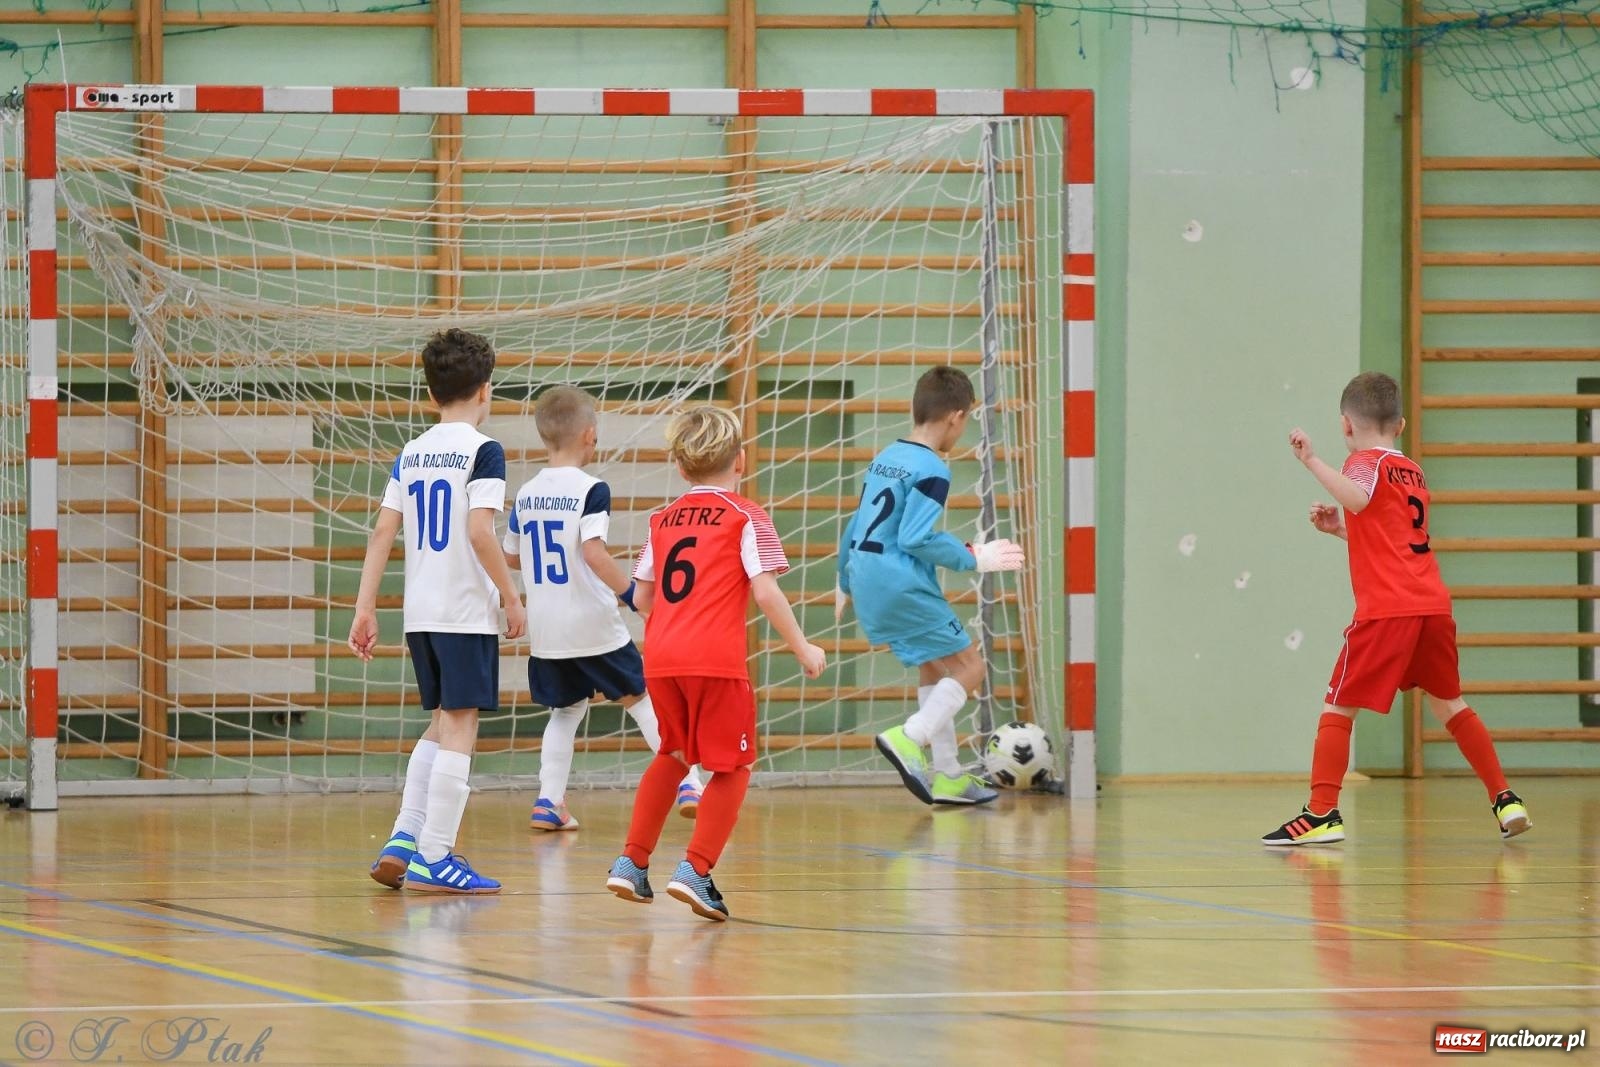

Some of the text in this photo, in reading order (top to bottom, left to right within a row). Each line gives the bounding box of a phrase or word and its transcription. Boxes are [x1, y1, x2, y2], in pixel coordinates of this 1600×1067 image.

[131, 92, 174, 106] sport
[408, 479, 452, 552] 10
[534, 496, 580, 512] RACIBÓRZ
[659, 507, 727, 530] KIETRZ
[523, 520, 569, 585] 15
[661, 536, 697, 604] 6
[740, 733, 748, 752] 6
